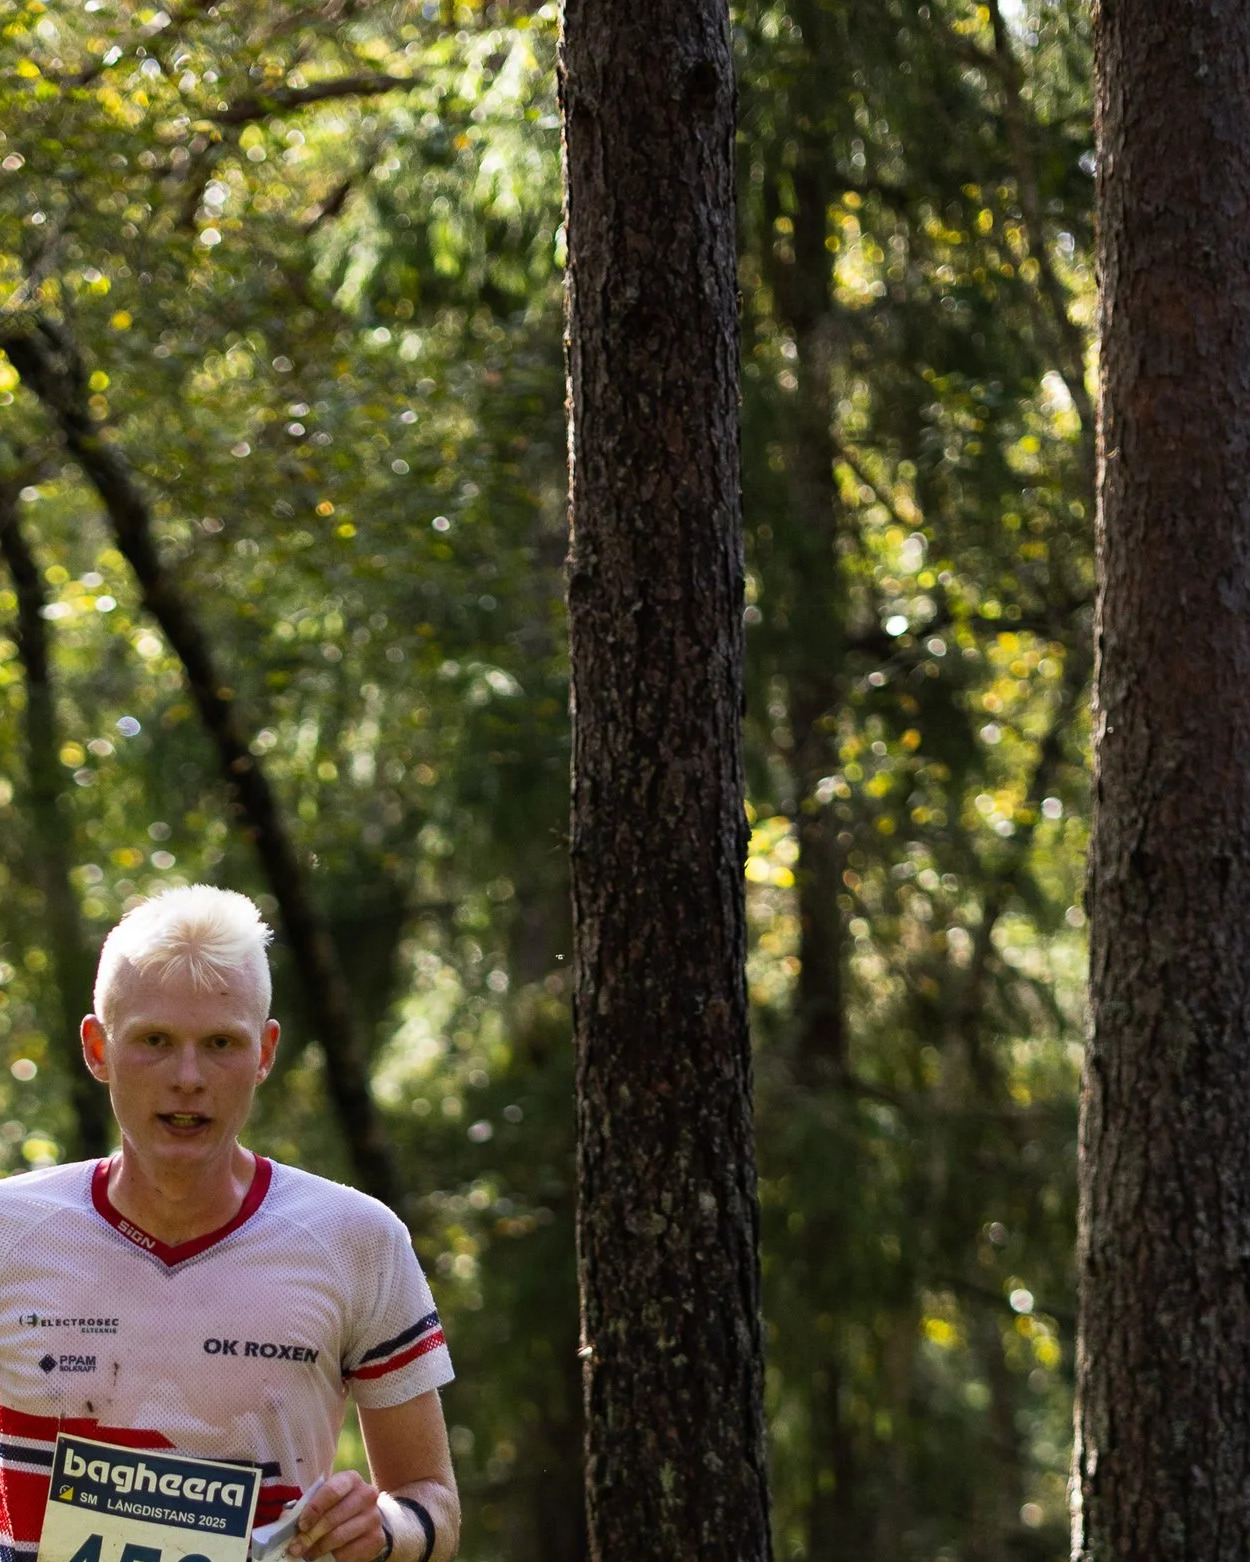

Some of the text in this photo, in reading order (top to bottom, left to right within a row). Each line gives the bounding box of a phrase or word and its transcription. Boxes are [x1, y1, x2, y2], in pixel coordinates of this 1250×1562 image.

[41, 1318, 119, 1327] ELECTROSEC
[59, 1355, 96, 1365] PPAM
[203, 1338, 320, 1364] OK ROXEN
[63, 1448, 245, 1507] bagheera
[80, 1492, 98, 1505] SM
[198, 1514, 227, 1529] 2025
